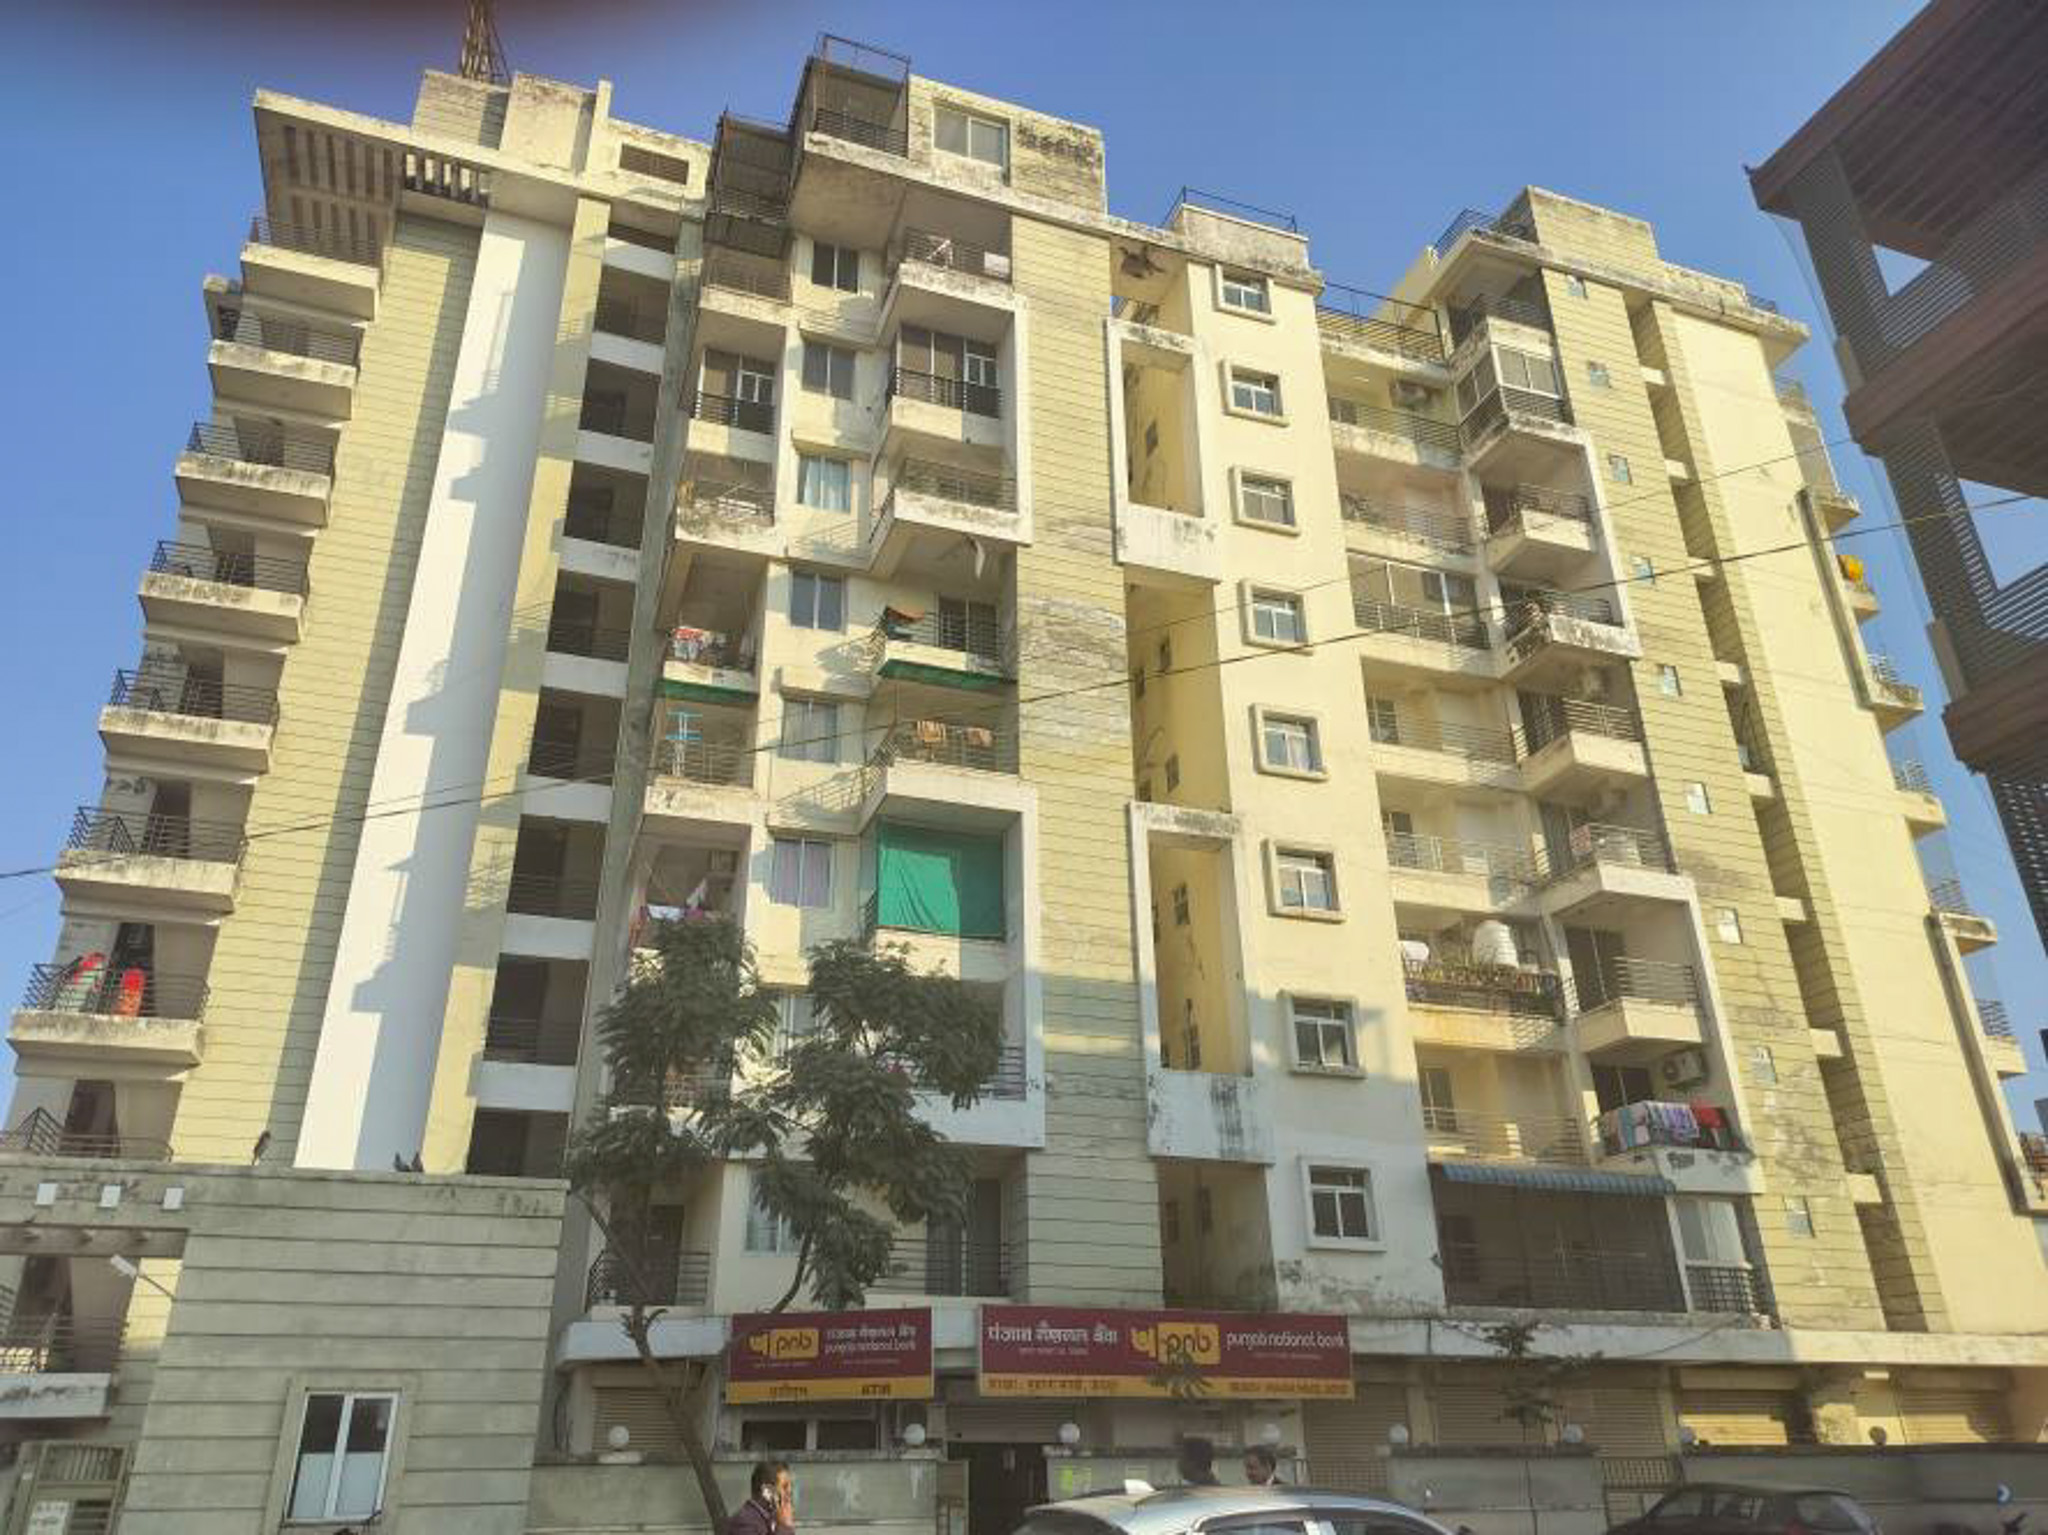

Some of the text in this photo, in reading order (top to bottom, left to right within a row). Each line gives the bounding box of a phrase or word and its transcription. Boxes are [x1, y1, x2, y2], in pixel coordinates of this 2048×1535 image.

[988, 1322, 1032, 1342] पंजाब
[1226, 1331, 1345, 1351] punjab national bank
[776, 1332, 812, 1355] pnb
[1166, 1329, 1211, 1358] pnb
